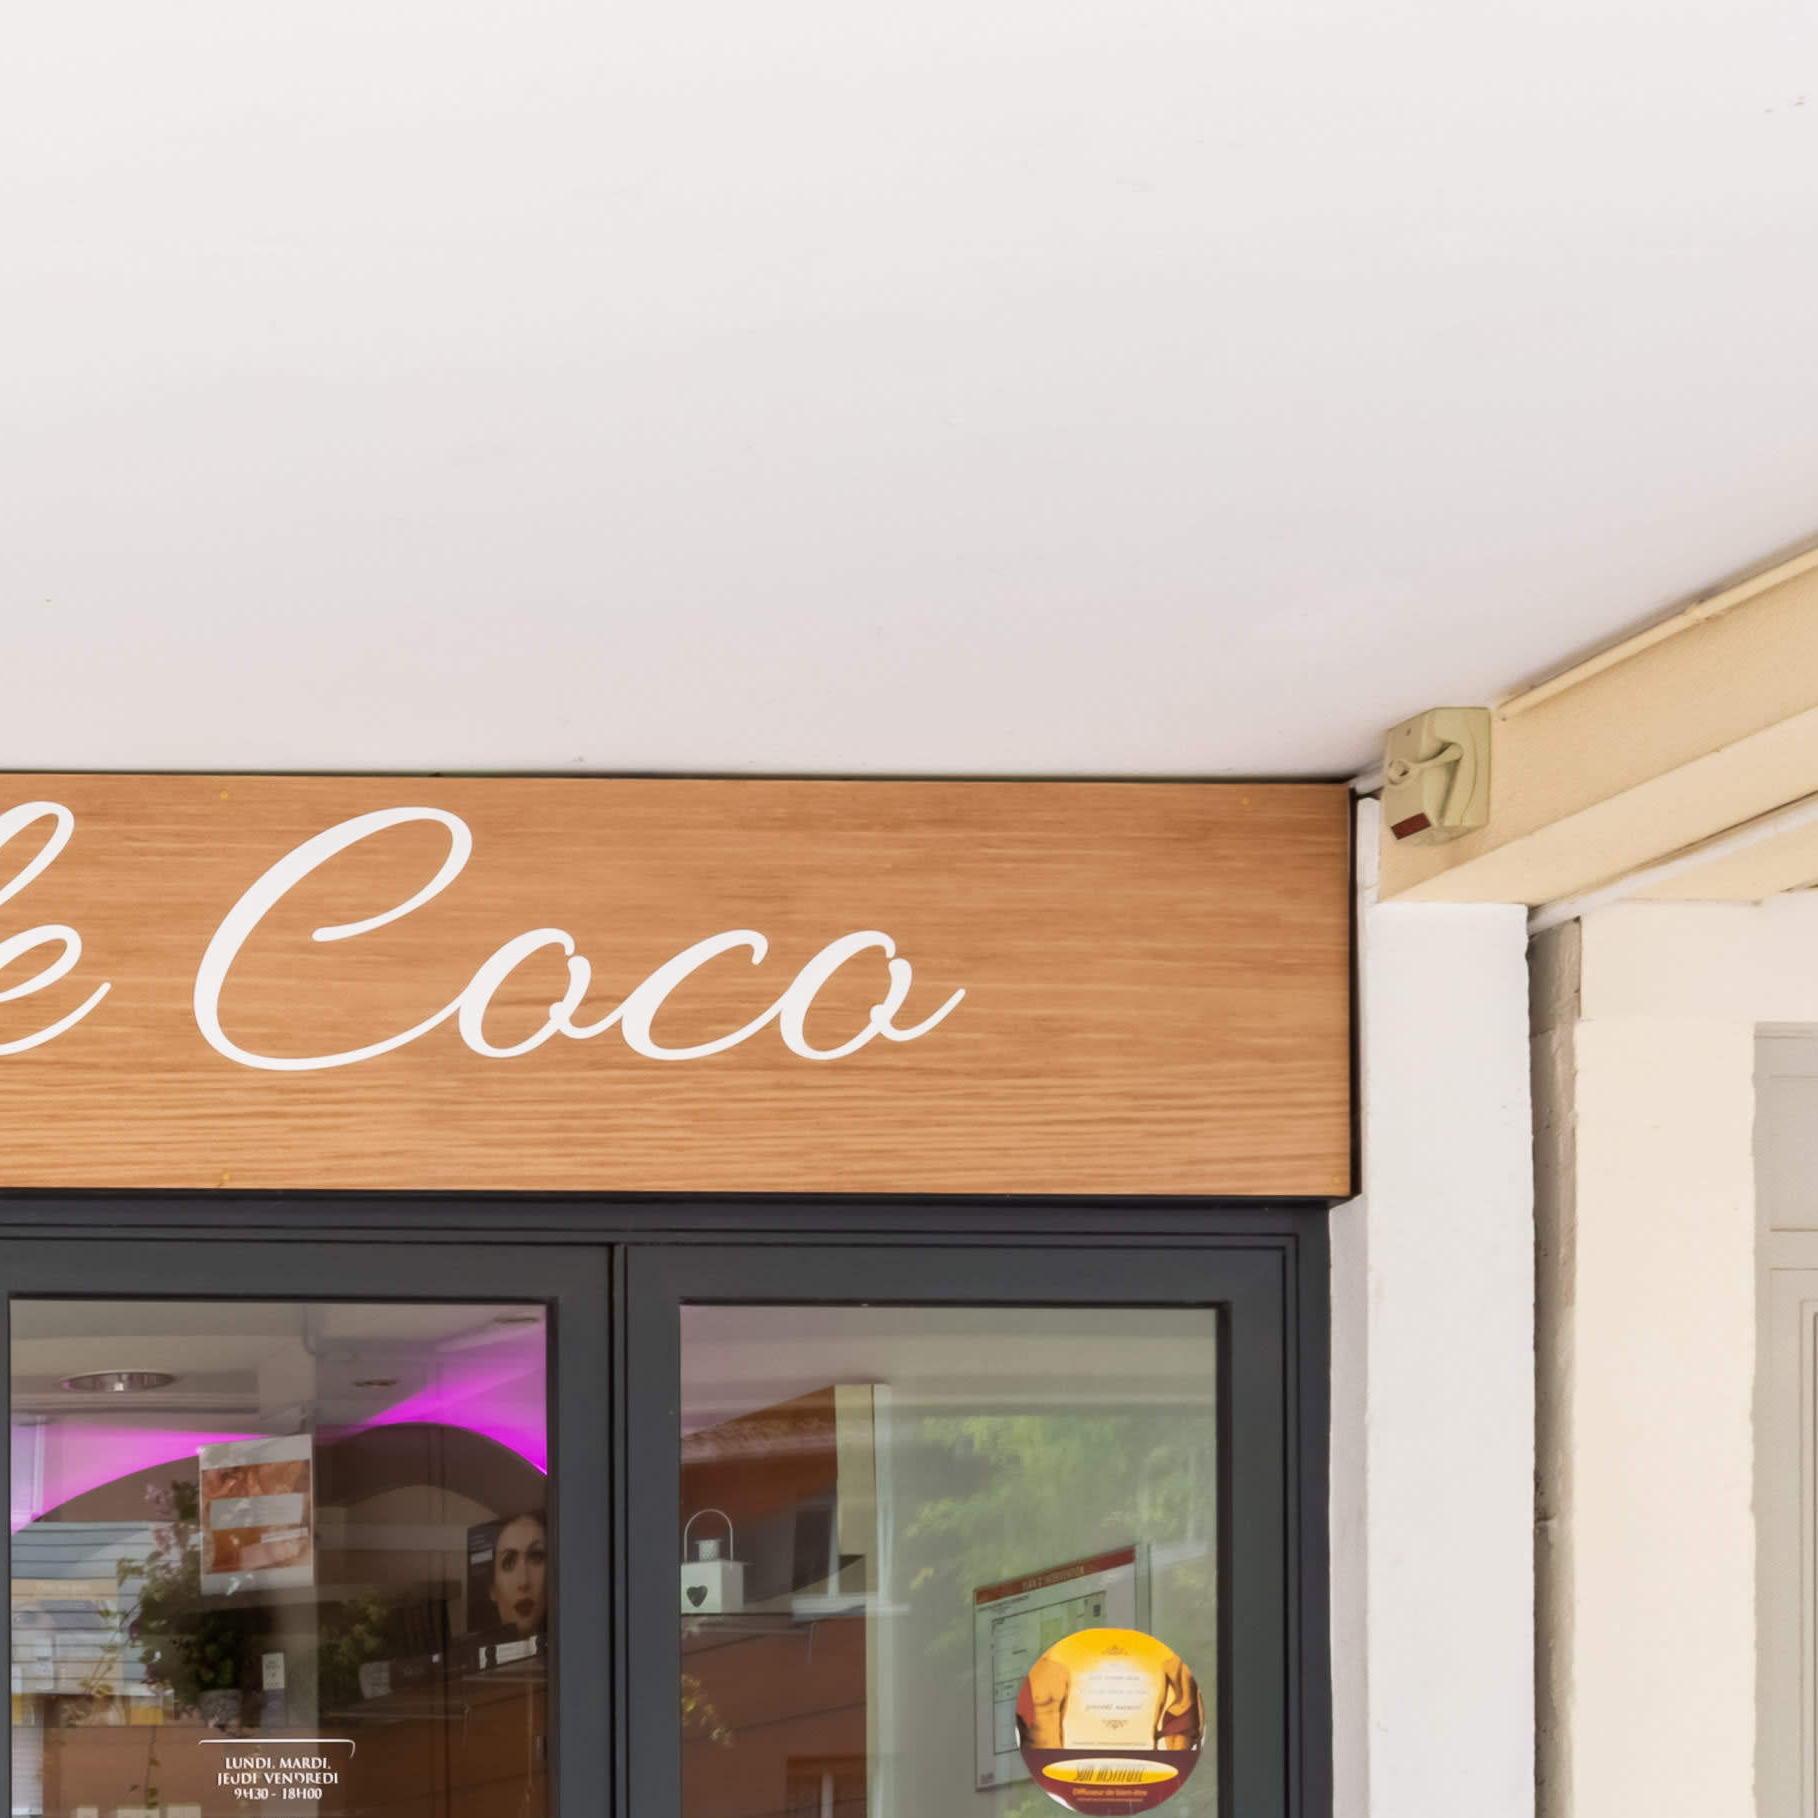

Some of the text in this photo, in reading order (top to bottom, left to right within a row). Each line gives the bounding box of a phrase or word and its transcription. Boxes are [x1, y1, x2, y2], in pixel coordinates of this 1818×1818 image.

[192, 805, 966, 1072] Coco
[234, 1788, 268, 1800] 9H30
[282, 1788, 322, 1800] 18H00
